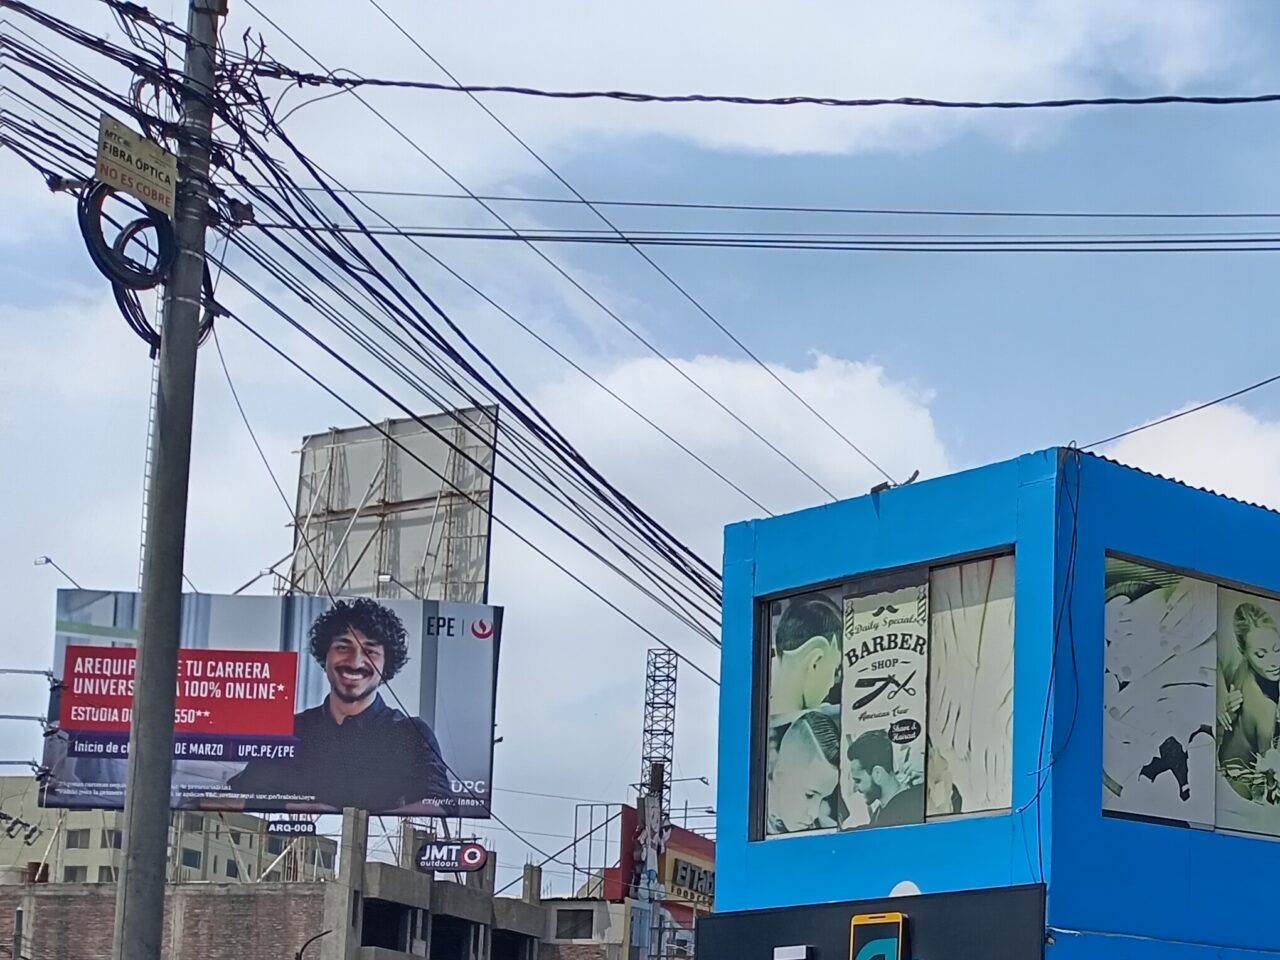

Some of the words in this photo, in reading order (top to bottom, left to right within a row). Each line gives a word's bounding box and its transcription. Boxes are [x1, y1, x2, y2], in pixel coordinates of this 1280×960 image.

[103, 141, 133, 165] FIBRA
[100, 163, 118, 180] NO
[120, 173, 134, 189] ES
[136, 182, 171, 208] COBRE
[426, 616, 456, 637] EPE
[854, 620, 879, 635] Daily
[845, 632, 927, 668] BARBER
[185, 660, 203, 678] TU
[206, 662, 271, 679] CARRERA
[871, 658, 899, 672] SHOP
[184, 681, 221, 698] 100%
[71, 706, 119, 723] ESTUDIA
[74, 740, 104, 753] Inicio
[106, 742, 118, 753] de
[189, 743, 224, 756] MARZO
[238, 744, 295, 758] UPC.PE/EPE
[451, 780, 485, 794] UPC
[268, 823, 313, 832] ARQ-008
[421, 845, 461, 861] JMT
